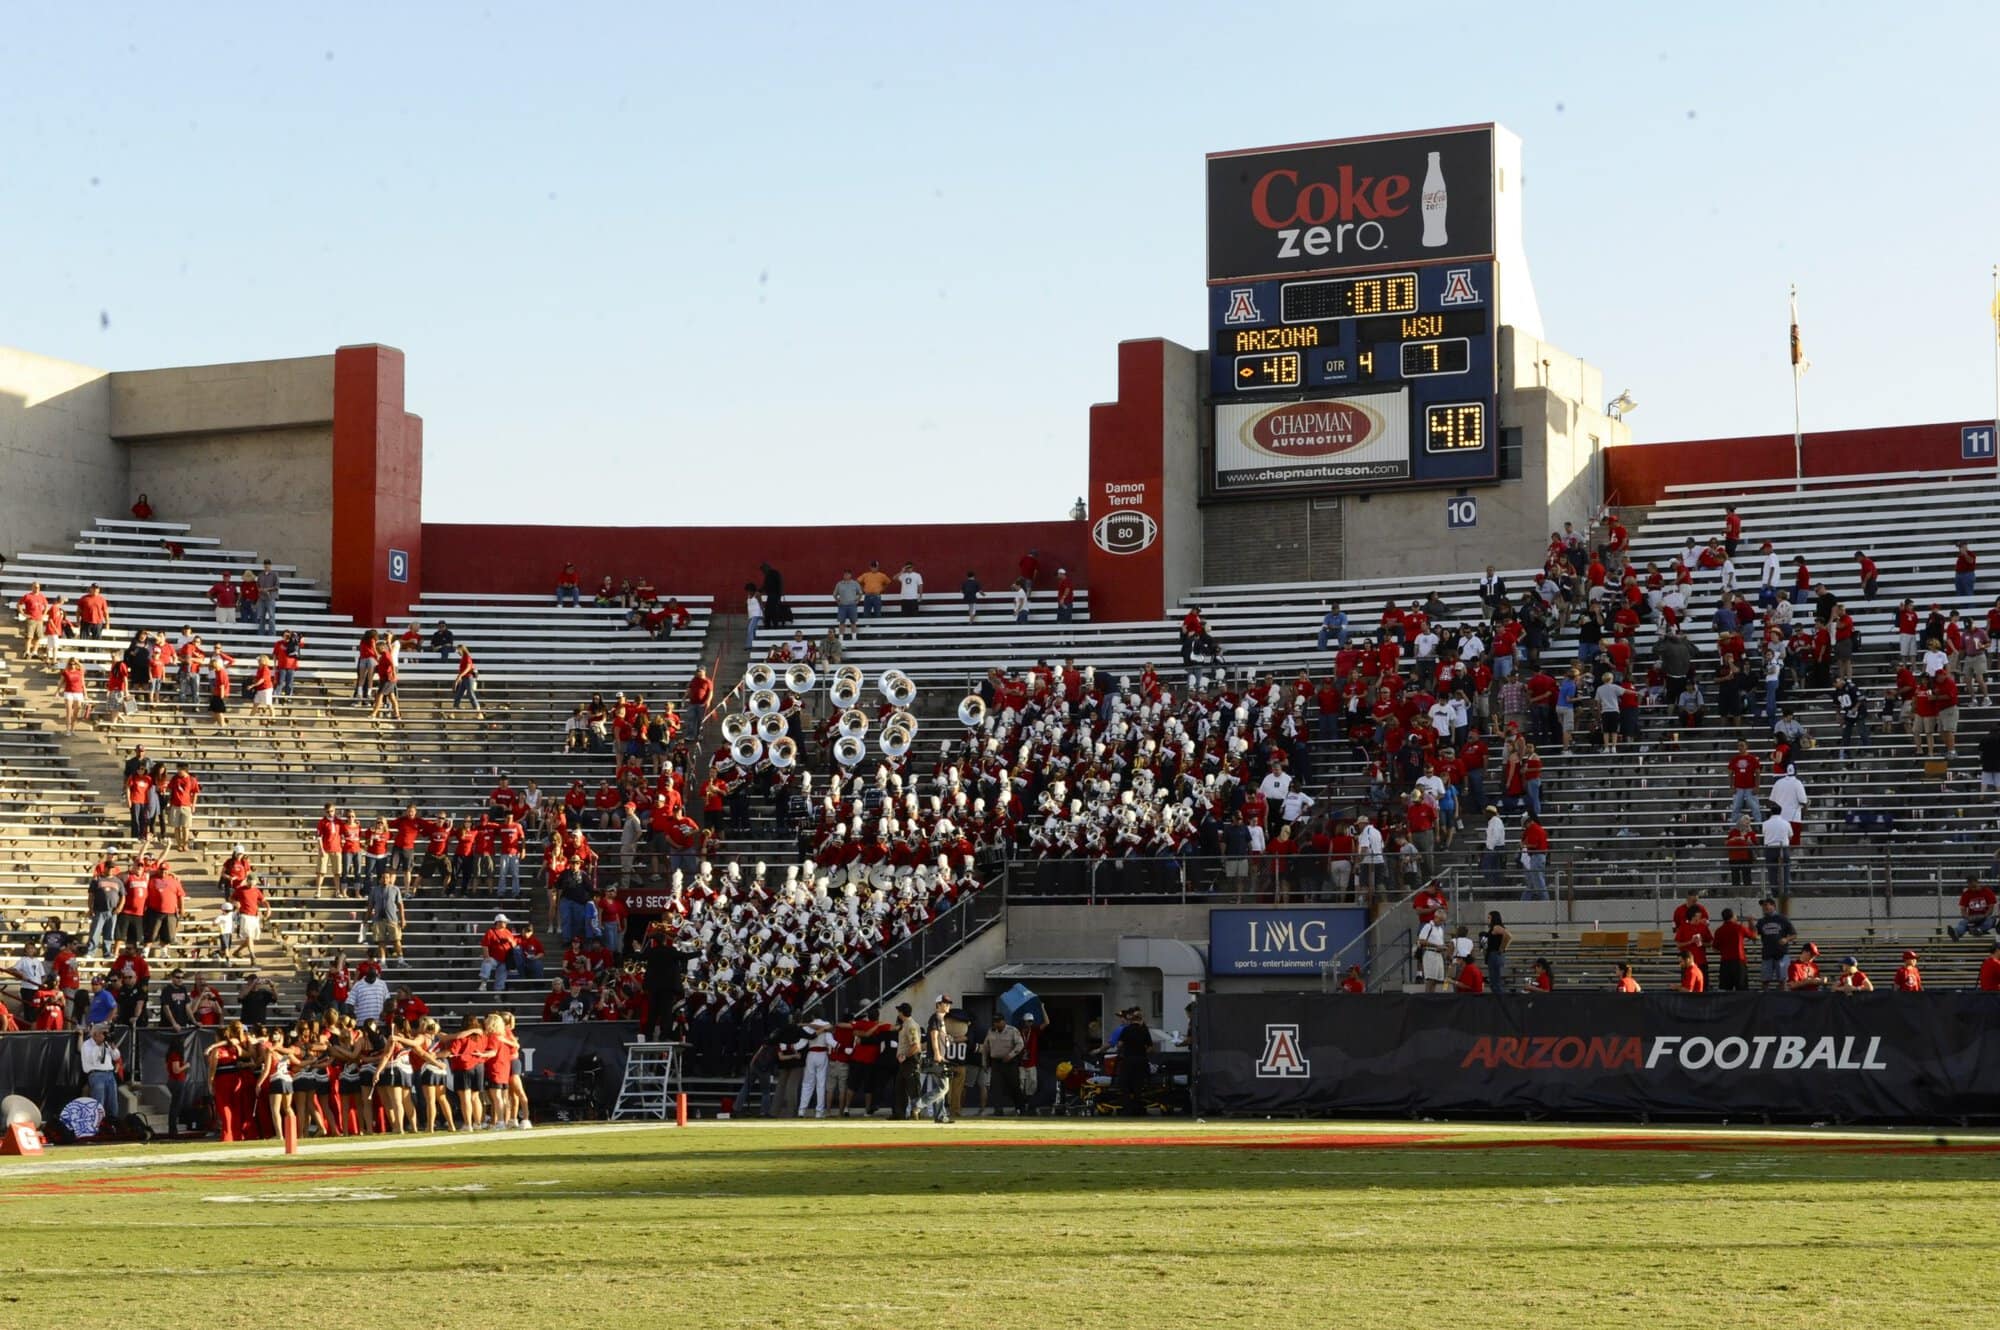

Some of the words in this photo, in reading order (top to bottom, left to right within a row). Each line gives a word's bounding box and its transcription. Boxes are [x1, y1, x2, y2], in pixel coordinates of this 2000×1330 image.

[1252, 164, 1411, 229] Coke
[1277, 221, 1385, 258] zero
[1441, 269, 1478, 306] A
[1225, 289, 1260, 324] A
[1236, 326, 1318, 352] ARIZONA
[1402, 316, 1443, 338] WSU
[1263, 356, 1296, 383] 48
[1359, 351, 1373, 374] 4
[1423, 345, 1438, 371] 7
[1270, 412, 1354, 436] CHAPMAN
[1431, 407, 1480, 448] 40
[1272, 434, 1353, 448] AUTOMOTIVE
[1967, 431, 1990, 452] 11
[1227, 463, 1399, 482] www.chapmantucson.com
[1105, 482, 1145, 493] Damon
[1108, 493, 1143, 506] Terrell
[1448, 501, 1476, 523] 10
[1118, 528, 1133, 538] 80
[393, 555, 404, 577] 9
[636, 896, 643, 908] 9
[1248, 920, 1328, 952] IMG
[1234, 960, 1257, 968] sports
[1262, 960, 1314, 968] entertainment
[1256, 1024, 1310, 1078] A
[1460, 1036, 1643, 1069] ARIZONA
[1645, 1036, 1887, 1069] FOOTBALL
